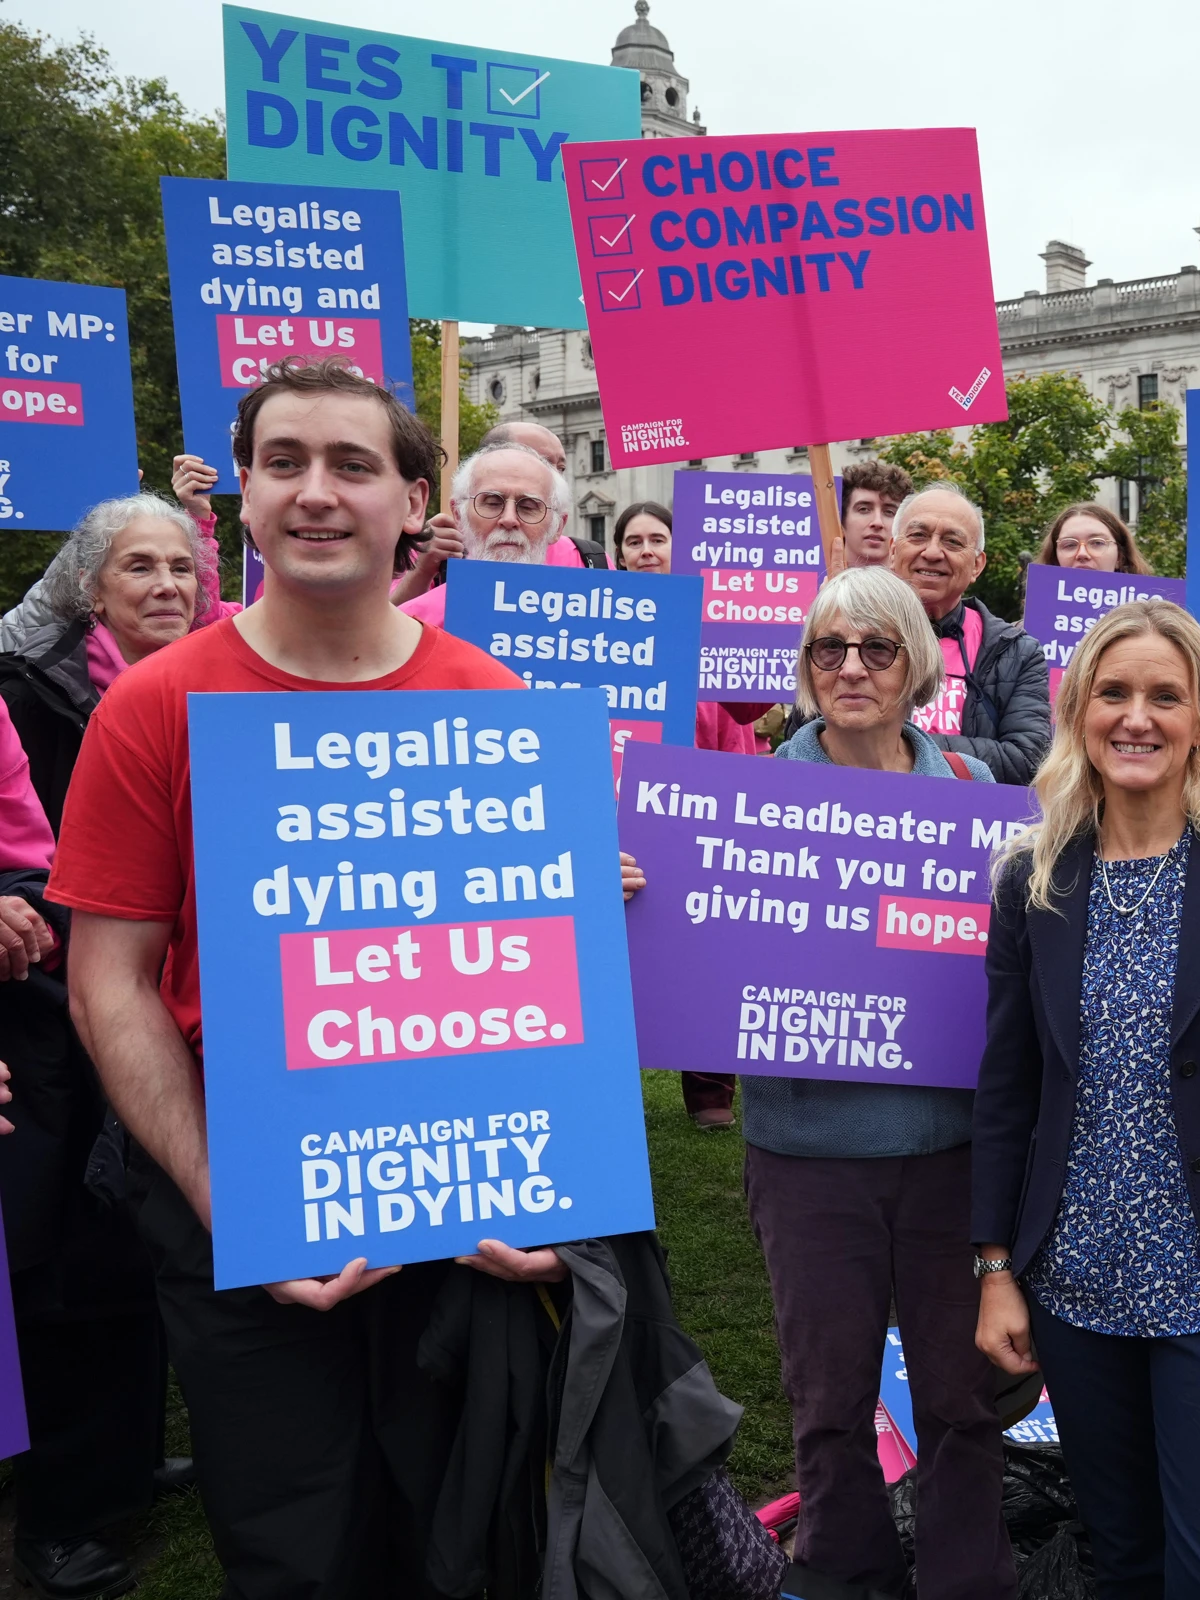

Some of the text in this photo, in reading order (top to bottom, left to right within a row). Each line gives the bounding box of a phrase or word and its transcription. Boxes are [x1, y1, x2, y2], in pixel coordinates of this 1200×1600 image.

[240, 21, 402, 101] YES
[247, 91, 570, 182] DIGNITY
[642, 147, 840, 197] CHOICE
[208, 196, 361, 234] Legalise
[650, 193, 975, 252] COMPASSION
[212, 239, 364, 271] assisted
[200, 276, 381, 314] dying and
[657, 250, 871, 306] DIGNITY
[47, 311, 115, 342] MP:
[234, 317, 356, 348] Let Us
[5, 345, 58, 374] for
[0, 387, 79, 418] ope.
[951, 389, 965, 404] YES
[620, 418, 683, 432] CAMPAIGN FOR
[621, 424, 683, 443] DIGNITY
[623, 435, 690, 453] IN DYING.
[704, 483, 812, 510] Legalise
[702, 513, 811, 537] assisted
[691, 540, 821, 569] dying and
[711, 570, 799, 594] Let Us
[493, 580, 657, 623] Legalise
[706, 599, 807, 623] Choose.
[489, 628, 655, 666] assisted
[699, 656, 797, 675] DIGNITY
[700, 646, 799, 659] CAMPAIGN FOR
[698, 672, 723, 689] IN
[911, 709, 961, 731] DYIN
[274, 716, 541, 780] Legalise
[276, 783, 546, 842] assisted
[636, 780, 718, 821] Kim
[734, 791, 957, 847] Leadbeater
[970, 817, 1040, 851] MP
[695, 835, 977, 894] Thank you for
[252, 850, 575, 926] dying and
[685, 884, 989, 945] giving us hope.
[312, 926, 531, 987] Let Us
[741, 984, 907, 1013] CAMPAIGN FOR
[306, 1004, 567, 1061] Choose.
[740, 1003, 905, 1041] DIGNITY
[736, 1031, 913, 1070] IN DYING.
[300, 1109, 551, 1157] CAMPAIGN FOR
[301, 1133, 552, 1200] DIGNITY
[304, 1173, 573, 1242] IN DYING.
